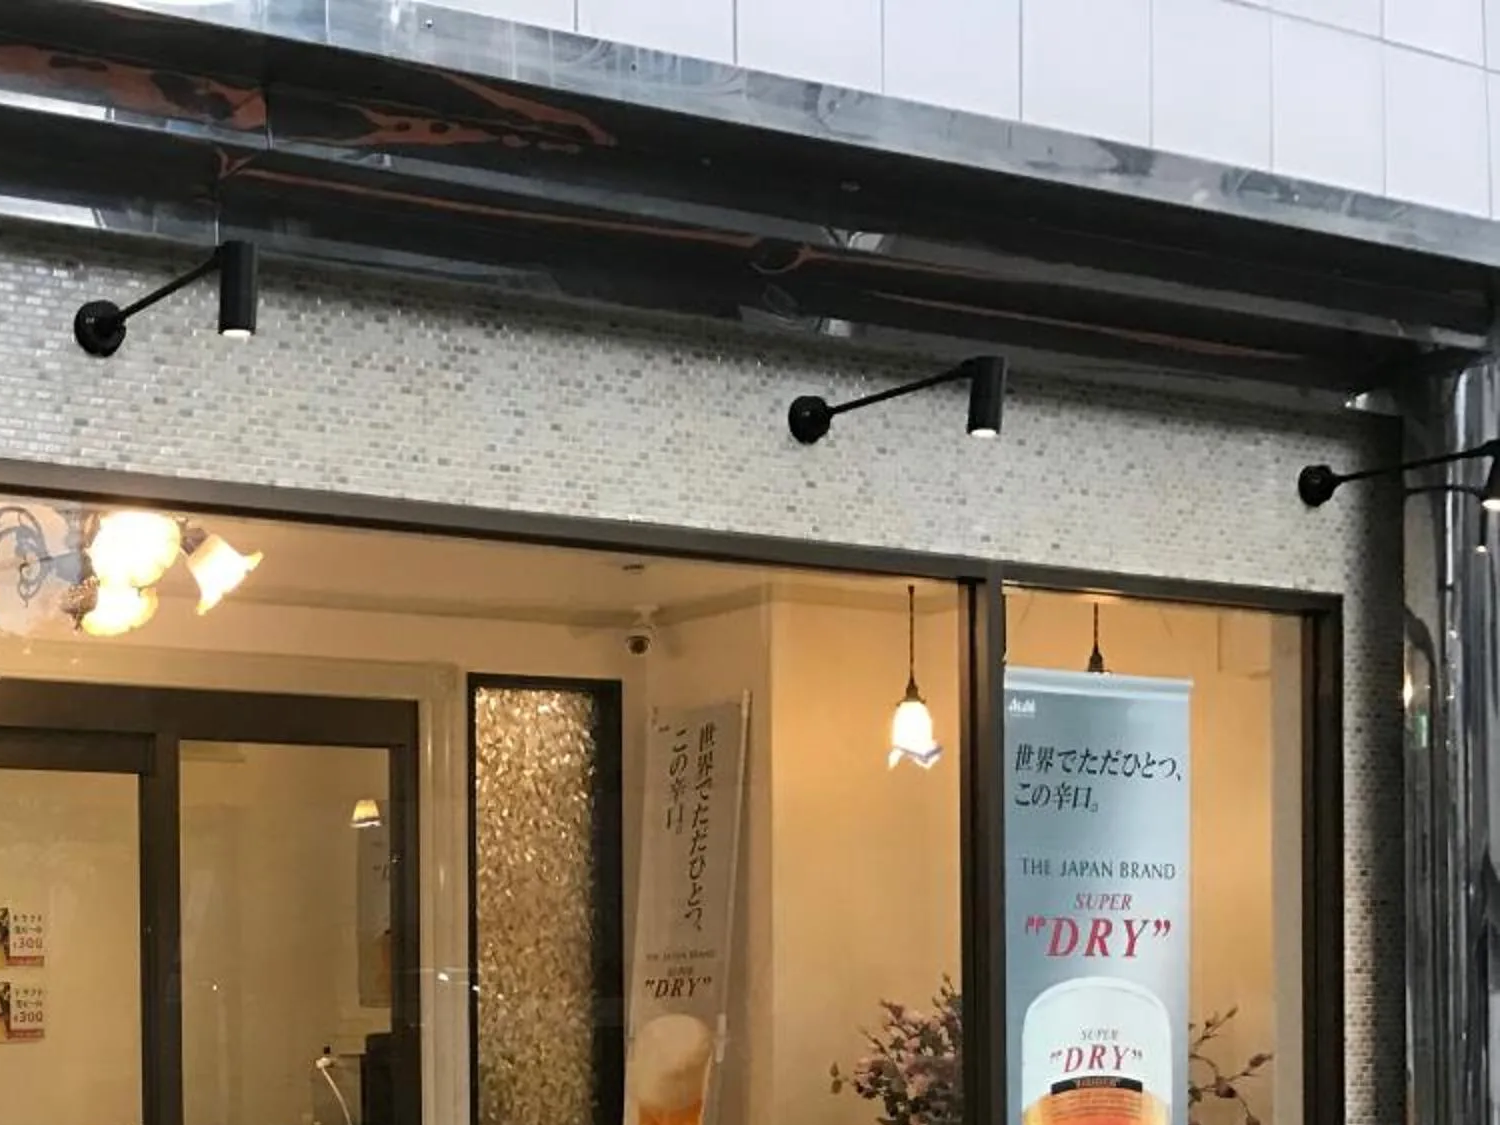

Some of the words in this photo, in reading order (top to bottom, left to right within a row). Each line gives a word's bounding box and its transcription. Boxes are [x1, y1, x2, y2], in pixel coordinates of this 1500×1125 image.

[1015, 743, 1181, 782] 世界でただひとつ、
[1015, 781, 1099, 813] この辛口。
[1019, 857, 1052, 876] THE
[1060, 858, 1113, 878] JAPAN
[1119, 861, 1176, 880] BRAND
[1075, 892, 1133, 911] SUPER
